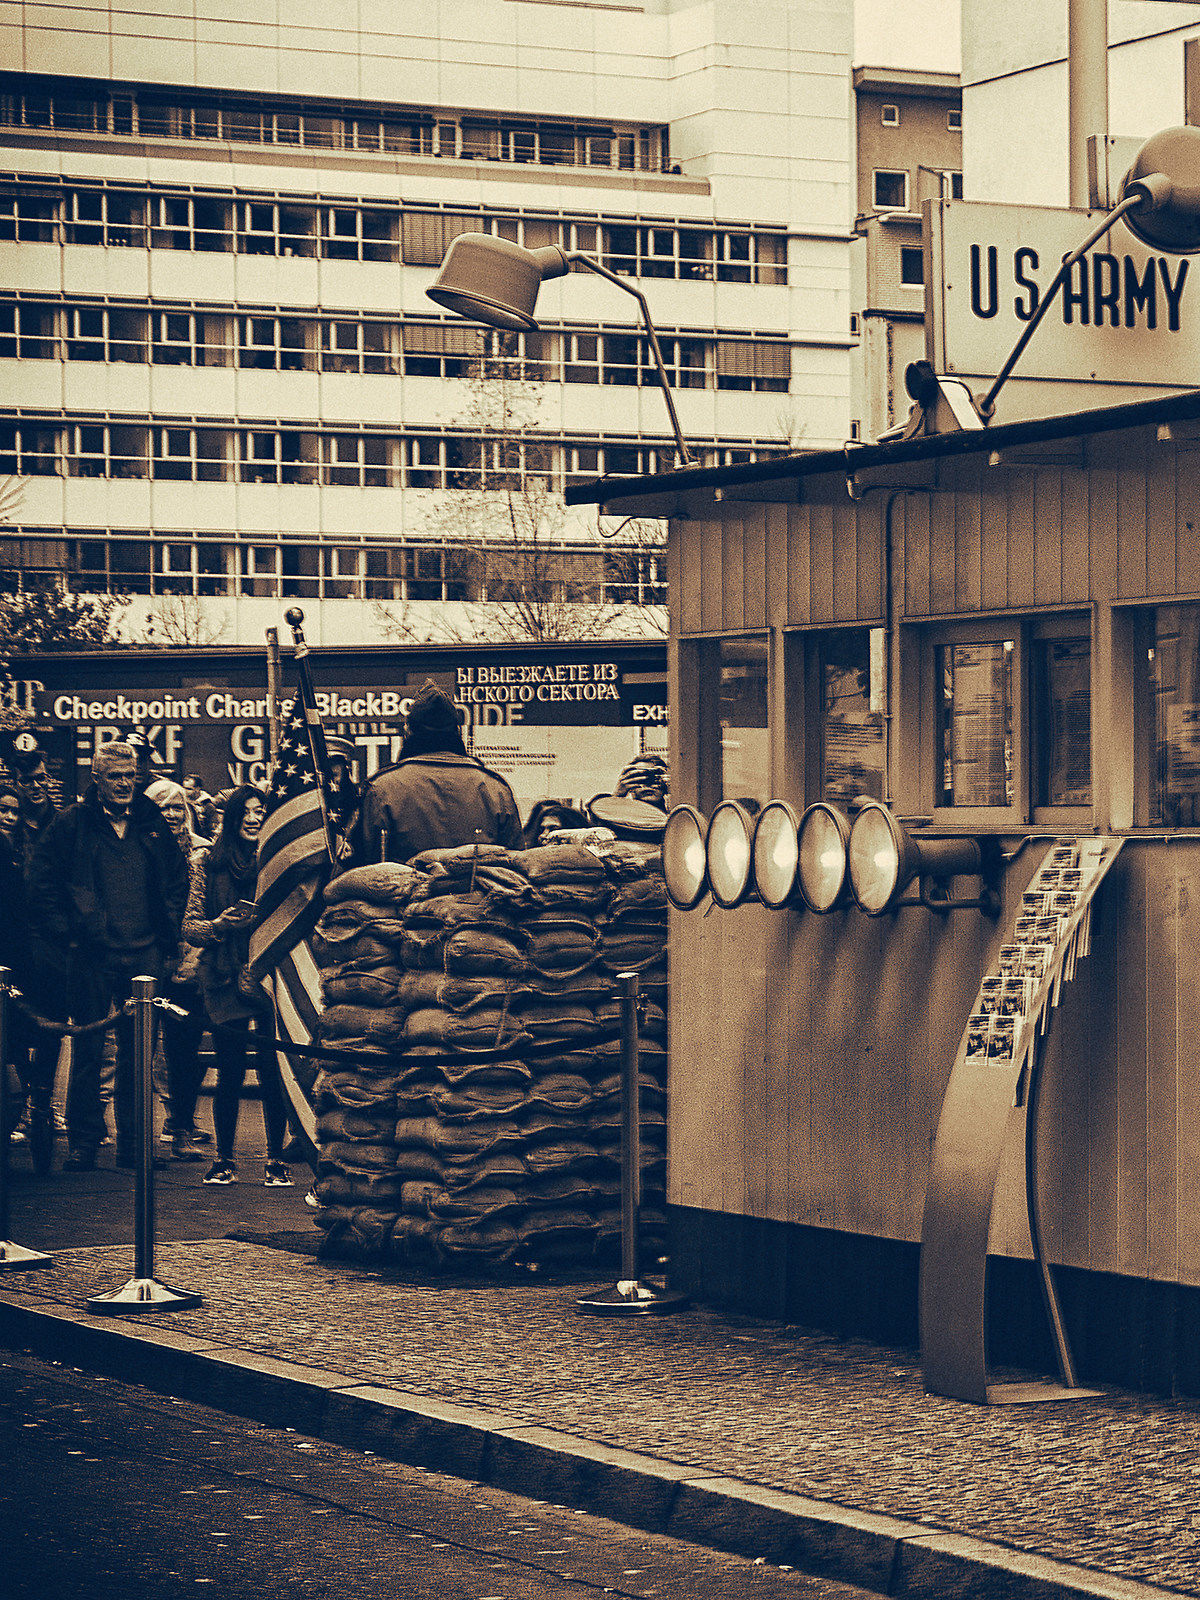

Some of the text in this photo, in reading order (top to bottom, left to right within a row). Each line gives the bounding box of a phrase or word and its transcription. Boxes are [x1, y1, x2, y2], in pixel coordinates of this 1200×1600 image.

[1061, 250, 1190, 333] ARMY
[456, 663, 619, 684] Ы ВЫЕЗЖАЕТЕ ИЗ
[454, 683, 621, 703] НСКОГО СЕКТОРА
[53, 695, 200, 724] Checkpoint
[205, 694, 297, 718] Charle
[314, 692, 416, 717] BlackBo
